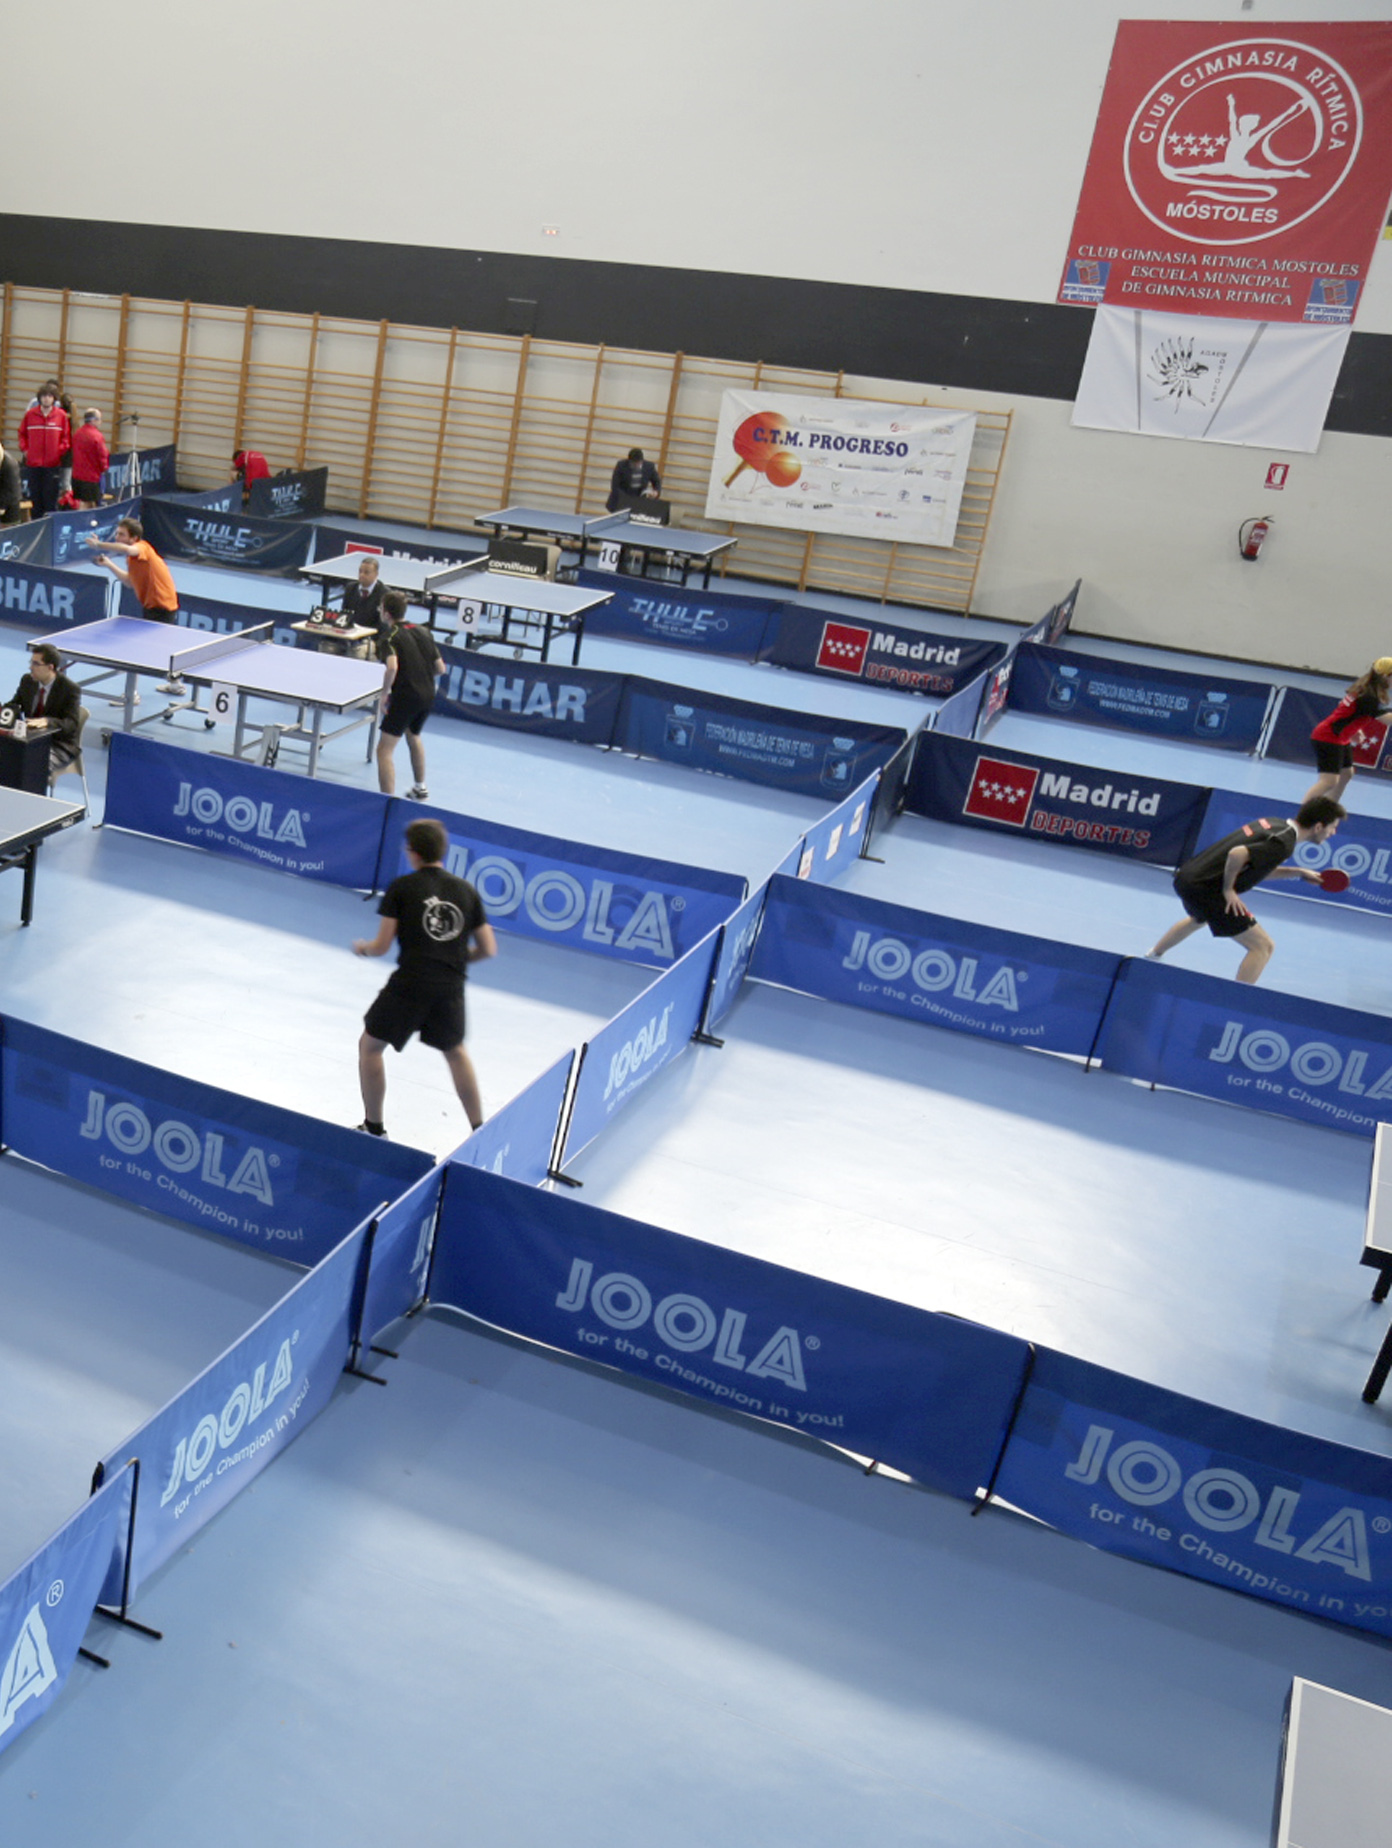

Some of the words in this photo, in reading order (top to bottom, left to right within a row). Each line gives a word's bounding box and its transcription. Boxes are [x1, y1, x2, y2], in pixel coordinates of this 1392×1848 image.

[1138, 92, 1176, 143] CLUB
[1305, 66, 1349, 151] RÍTMICA
[1165, 201, 1279, 224] MÓSTOLES
[1077, 244, 1119, 260] CLUB
[1121, 248, 1198, 266] GIMNASIA
[1201, 254, 1269, 271] RITMICA
[1271, 260, 1360, 277] MOSTOLES
[1130, 265, 1199, 282] ESCUELA
[1202, 271, 1291, 289] MUNICIPAL
[1121, 281, 1144, 294] DE
[1145, 283, 1223, 301] GIMNASIA
[1225, 289, 1293, 306] RITMICA
[752, 427, 804, 448] C.T.M.
[808, 433, 909, 458] PROGRESO
[488, 558, 538, 575] cornilleau
[601, 549, 619, 565] 10
[311, 609, 324, 623] 3
[335, 614, 348, 628] 4
[461, 606, 474, 625] 8
[872, 632, 960, 666] Madrid
[866, 662, 954, 693] DEPORTES
[0, 708, 14, 725] 9
[215, 692, 230, 713] 6
[173, 782, 307, 848] JOOLA
[1039, 773, 1161, 817] Madrid
[186, 825, 203, 836] for
[206, 828, 225, 841] the
[228, 836, 283, 866] Champion
[286, 858, 297, 869] in
[299, 860, 325, 872] you!
[1031, 810, 1151, 849] DEPORTES
[842, 930, 1019, 1012] JOOLA
[858, 981, 879, 993] for
[882, 985, 906, 1000] the
[910, 994, 987, 1030] Champion
[990, 1022, 1006, 1034] in
[1010, 1024, 1045, 1036] you!
[1226, 1074, 1252, 1087] for
[1255, 1079, 1283, 1094] the
[1287, 1087, 1376, 1128] Champion
[79, 1089, 274, 1207] JOOLA
[99, 1154, 122, 1169] for
[126, 1160, 153, 1181] the
[156, 1174, 239, 1229] Champion
[243, 1219, 259, 1235] in
[265, 1227, 304, 1241] you!
[555, 1257, 807, 1392] JOOLA
[577, 1328, 609, 1346] for
[614, 1336, 649, 1360] the
[654, 1354, 763, 1411] Champion
[769, 1402, 789, 1418] in
[795, 1410, 845, 1428] you!
[160, 1337, 293, 1508] JOOLA
[174, 1493, 192, 1519] for
[194, 1472, 214, 1496] the
[215, 1426, 275, 1476] Champion
[276, 1413, 289, 1432] in
[1064, 1423, 1372, 1583] JOOLA
[1089, 1503, 1125, 1525] for
[1132, 1513, 1172, 1541] the
[1178, 1533, 1310, 1602] Champion
[1319, 1593, 1345, 1611] in
